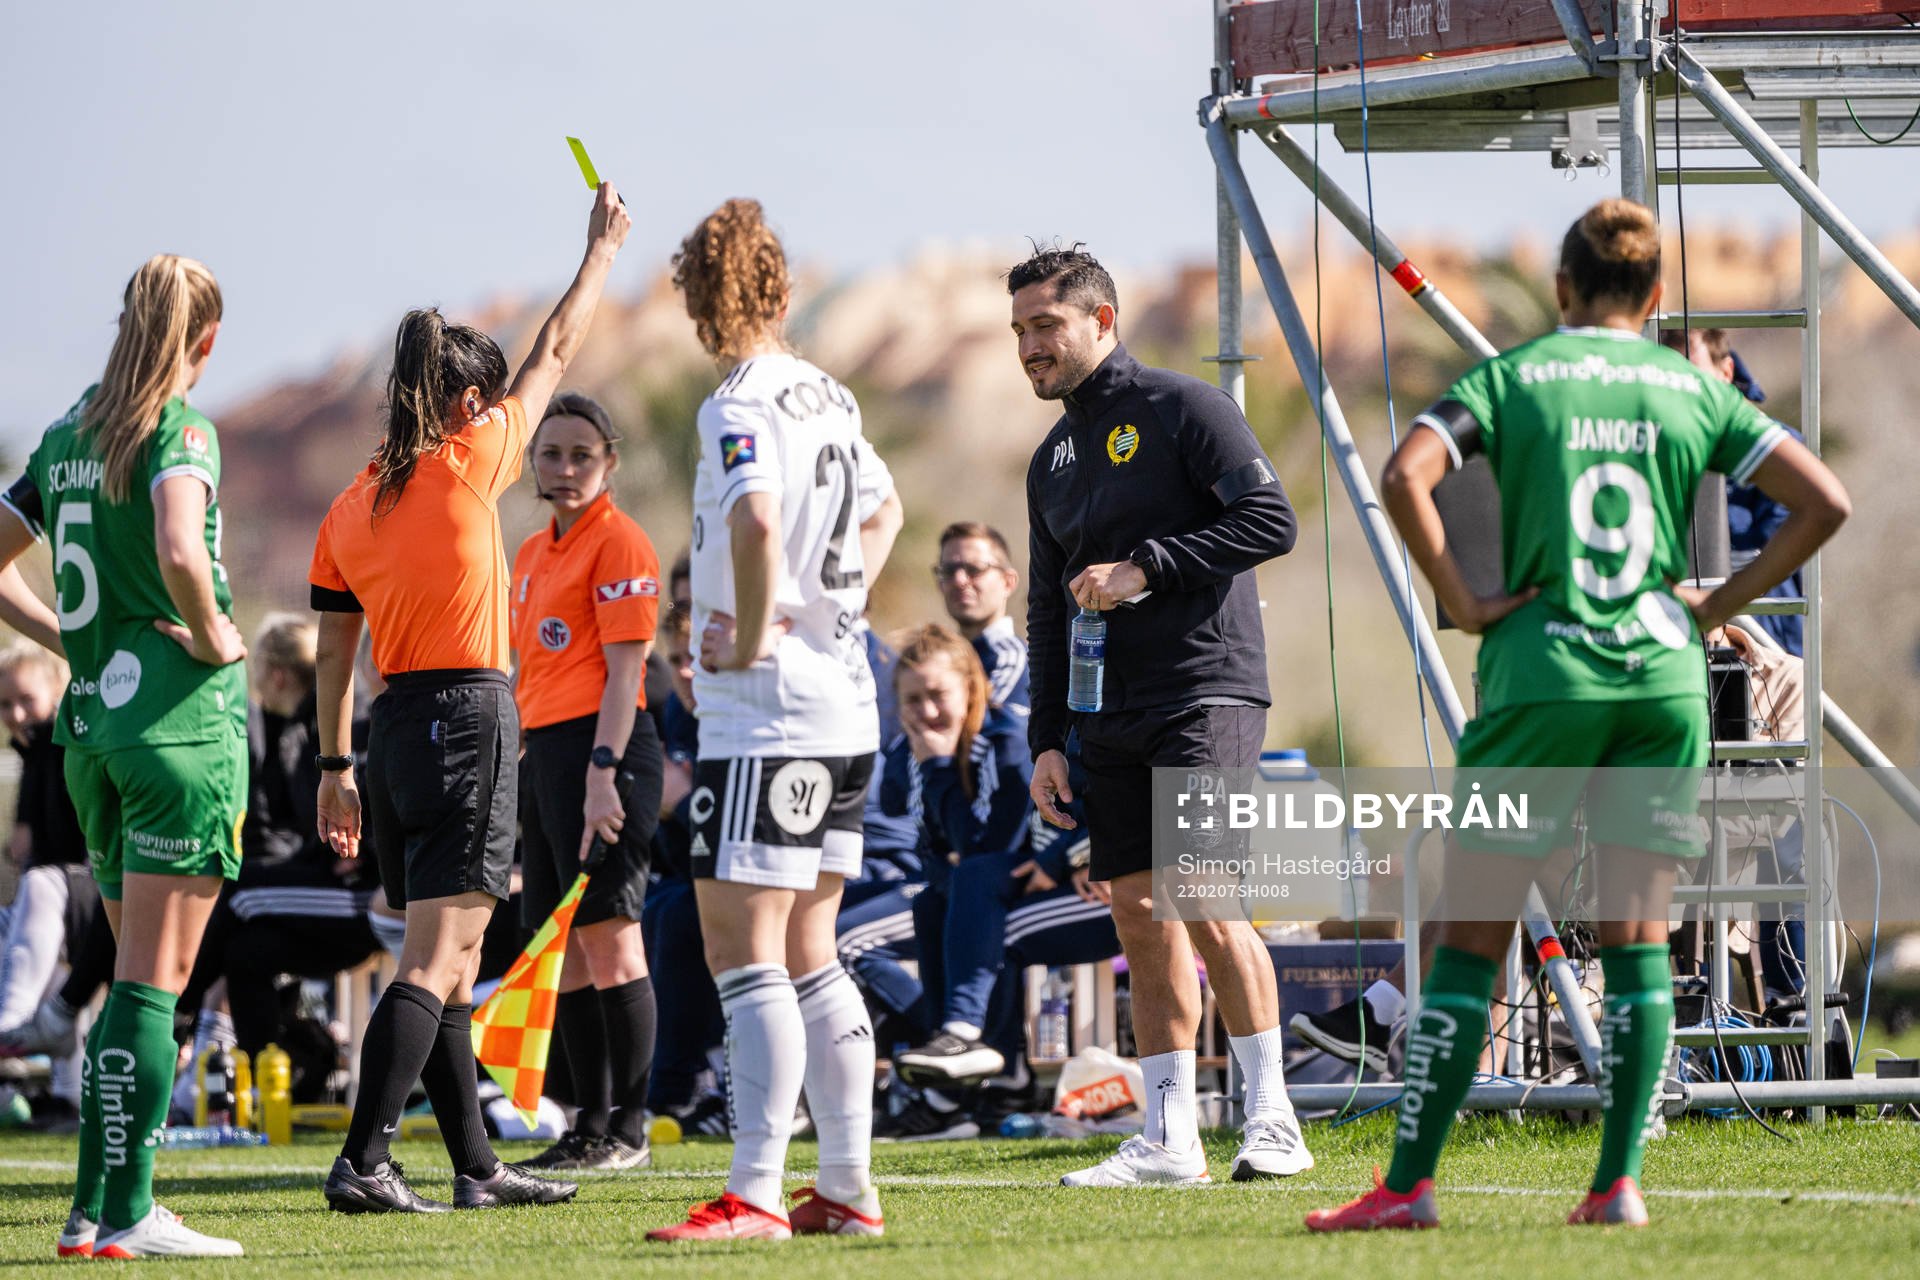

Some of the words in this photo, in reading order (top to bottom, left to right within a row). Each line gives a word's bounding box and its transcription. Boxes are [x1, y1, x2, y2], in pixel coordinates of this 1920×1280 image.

[1050, 435, 1076, 472] PPA
[1566, 415, 1662, 456] JANOGY
[55, 501, 100, 632] 5
[815, 440, 864, 590] 2
[1569, 462, 1656, 600] 9
[600, 578, 658, 600] VG
[1187, 773, 1227, 805] PPA
[97, 1047, 136, 1168] Clinton
[1396, 1008, 1458, 1142] Clinton
